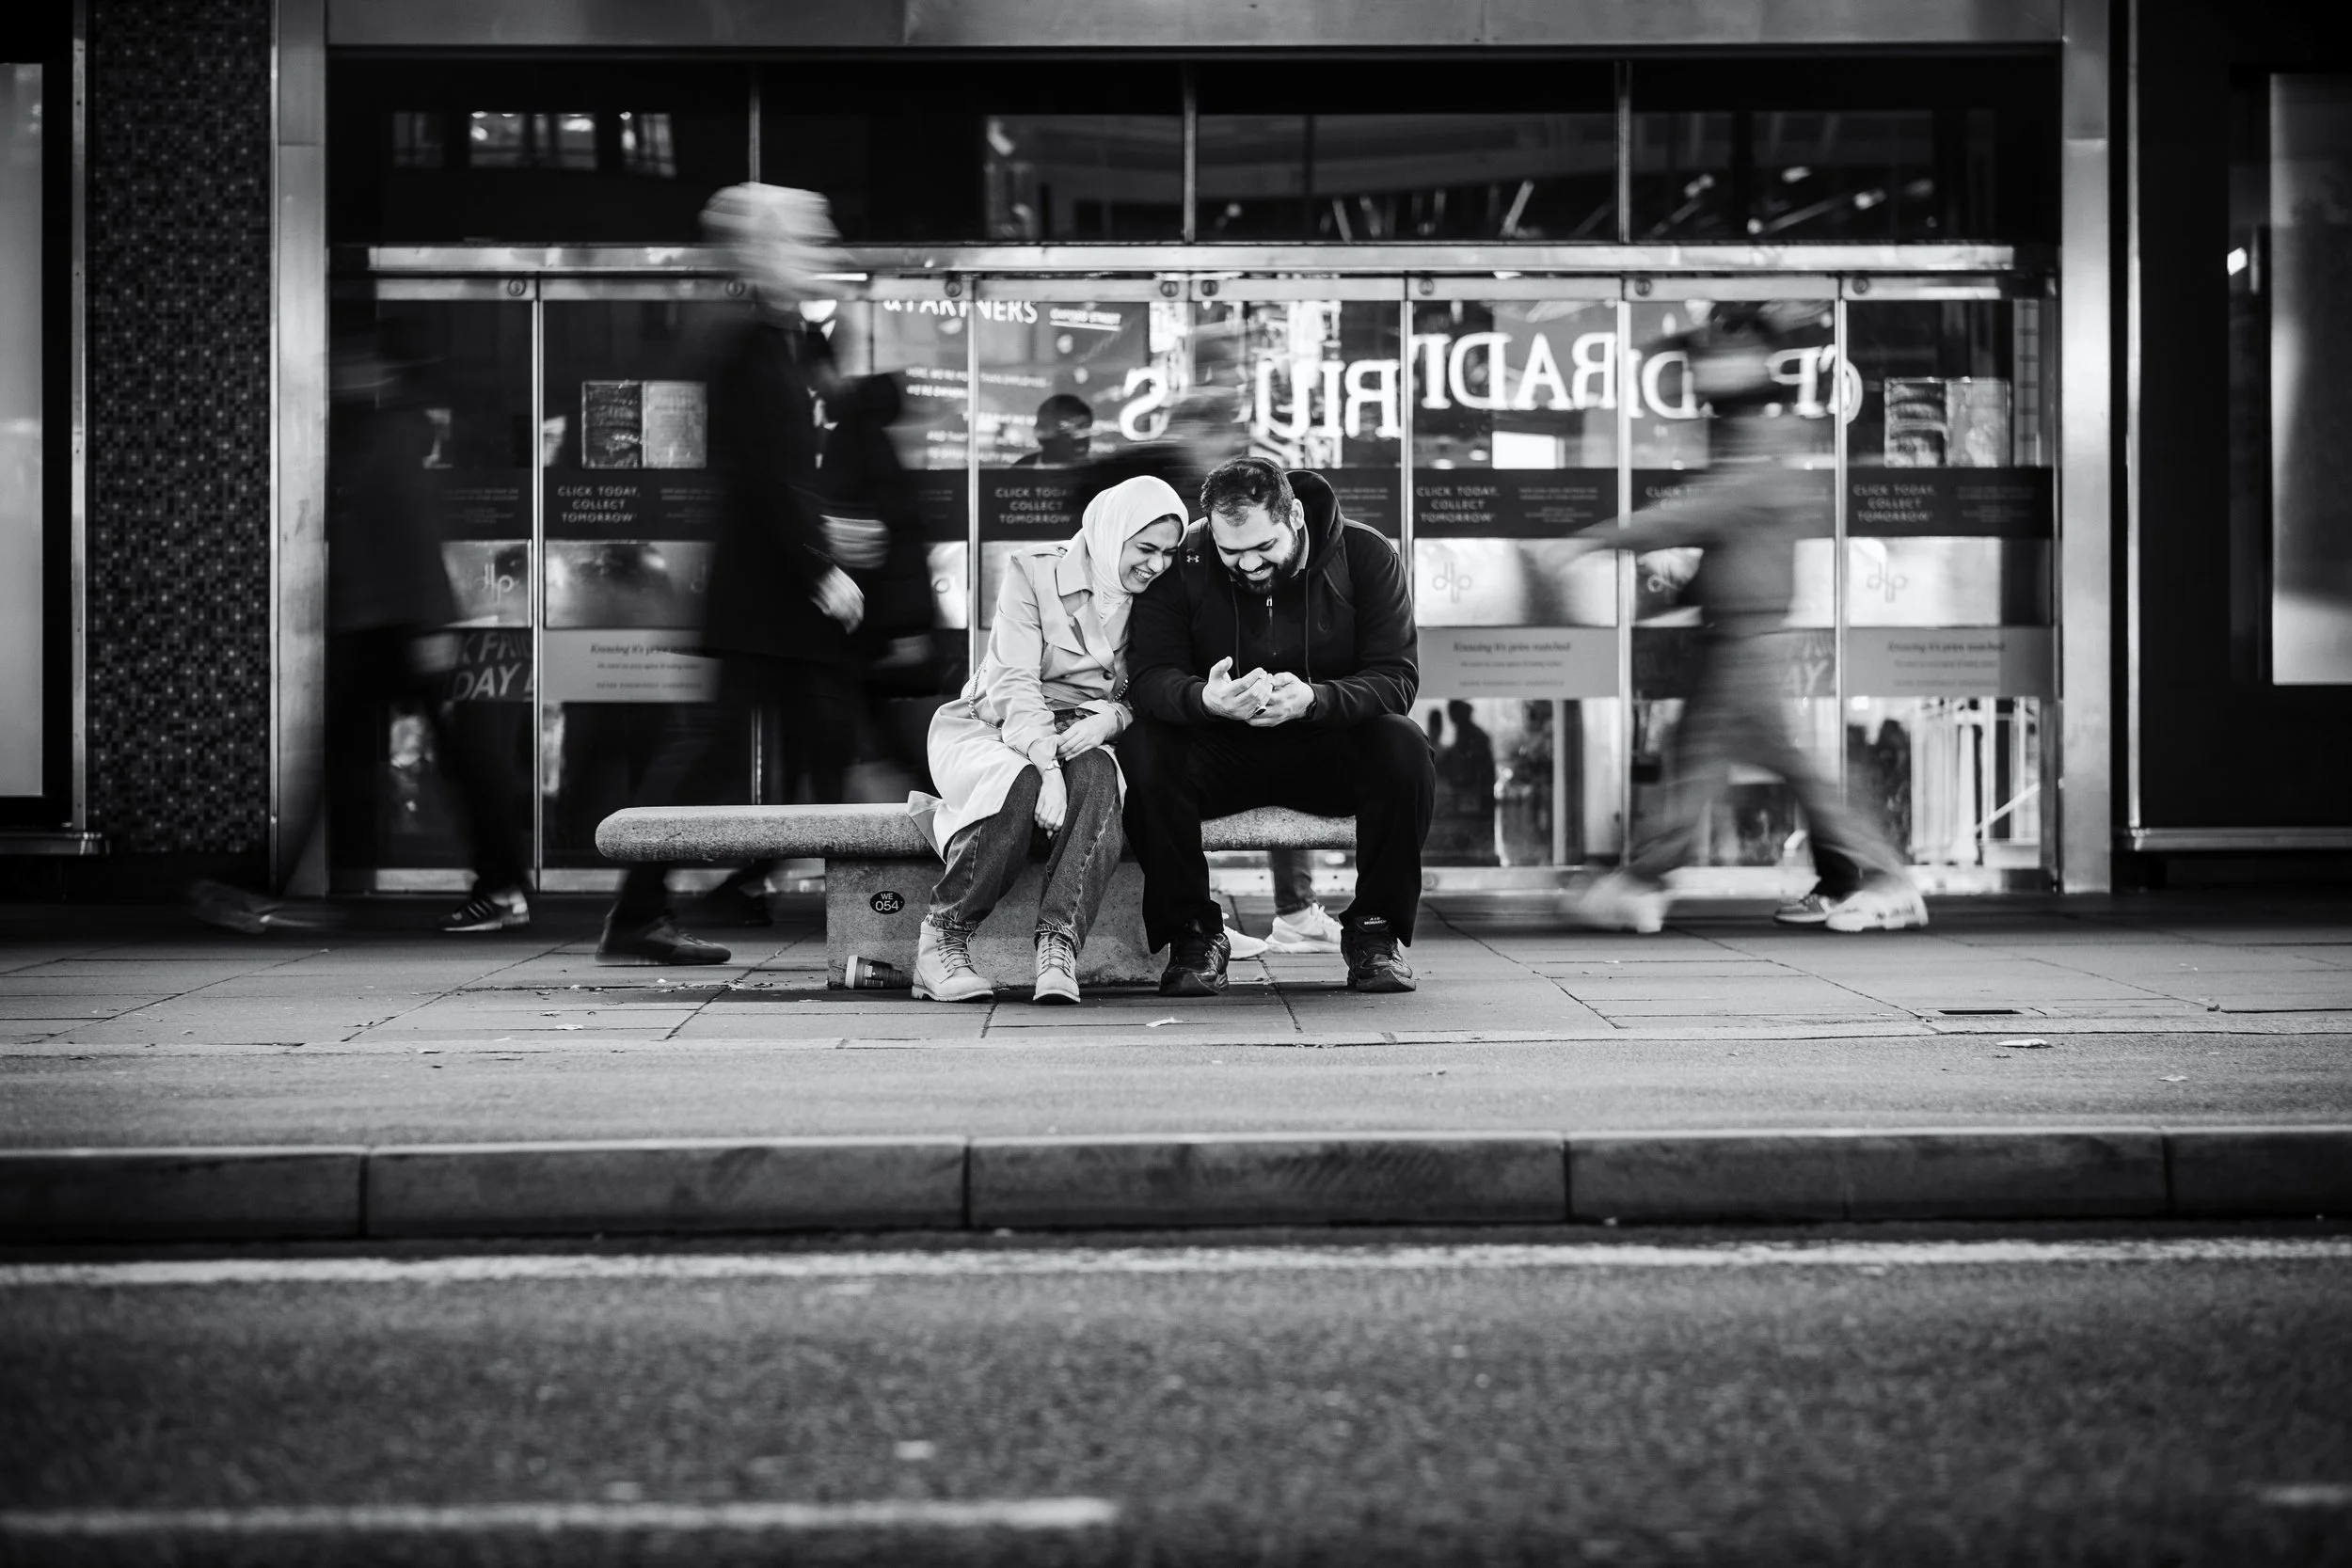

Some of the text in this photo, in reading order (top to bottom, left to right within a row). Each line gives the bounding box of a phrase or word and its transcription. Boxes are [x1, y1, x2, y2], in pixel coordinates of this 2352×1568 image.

[557, 484, 593, 497] CLICK
[994, 486, 1030, 498] CLICK
[1415, 485, 1453, 497] CLICK
[1852, 483, 1888, 497] CLICK
[572, 499, 627, 511] COLLECT
[1009, 500, 1063, 511] COLLECT
[1430, 499, 1486, 510] COLLECT
[1867, 498, 1922, 509] COLLECT
[875, 900, 899, 911] 054
